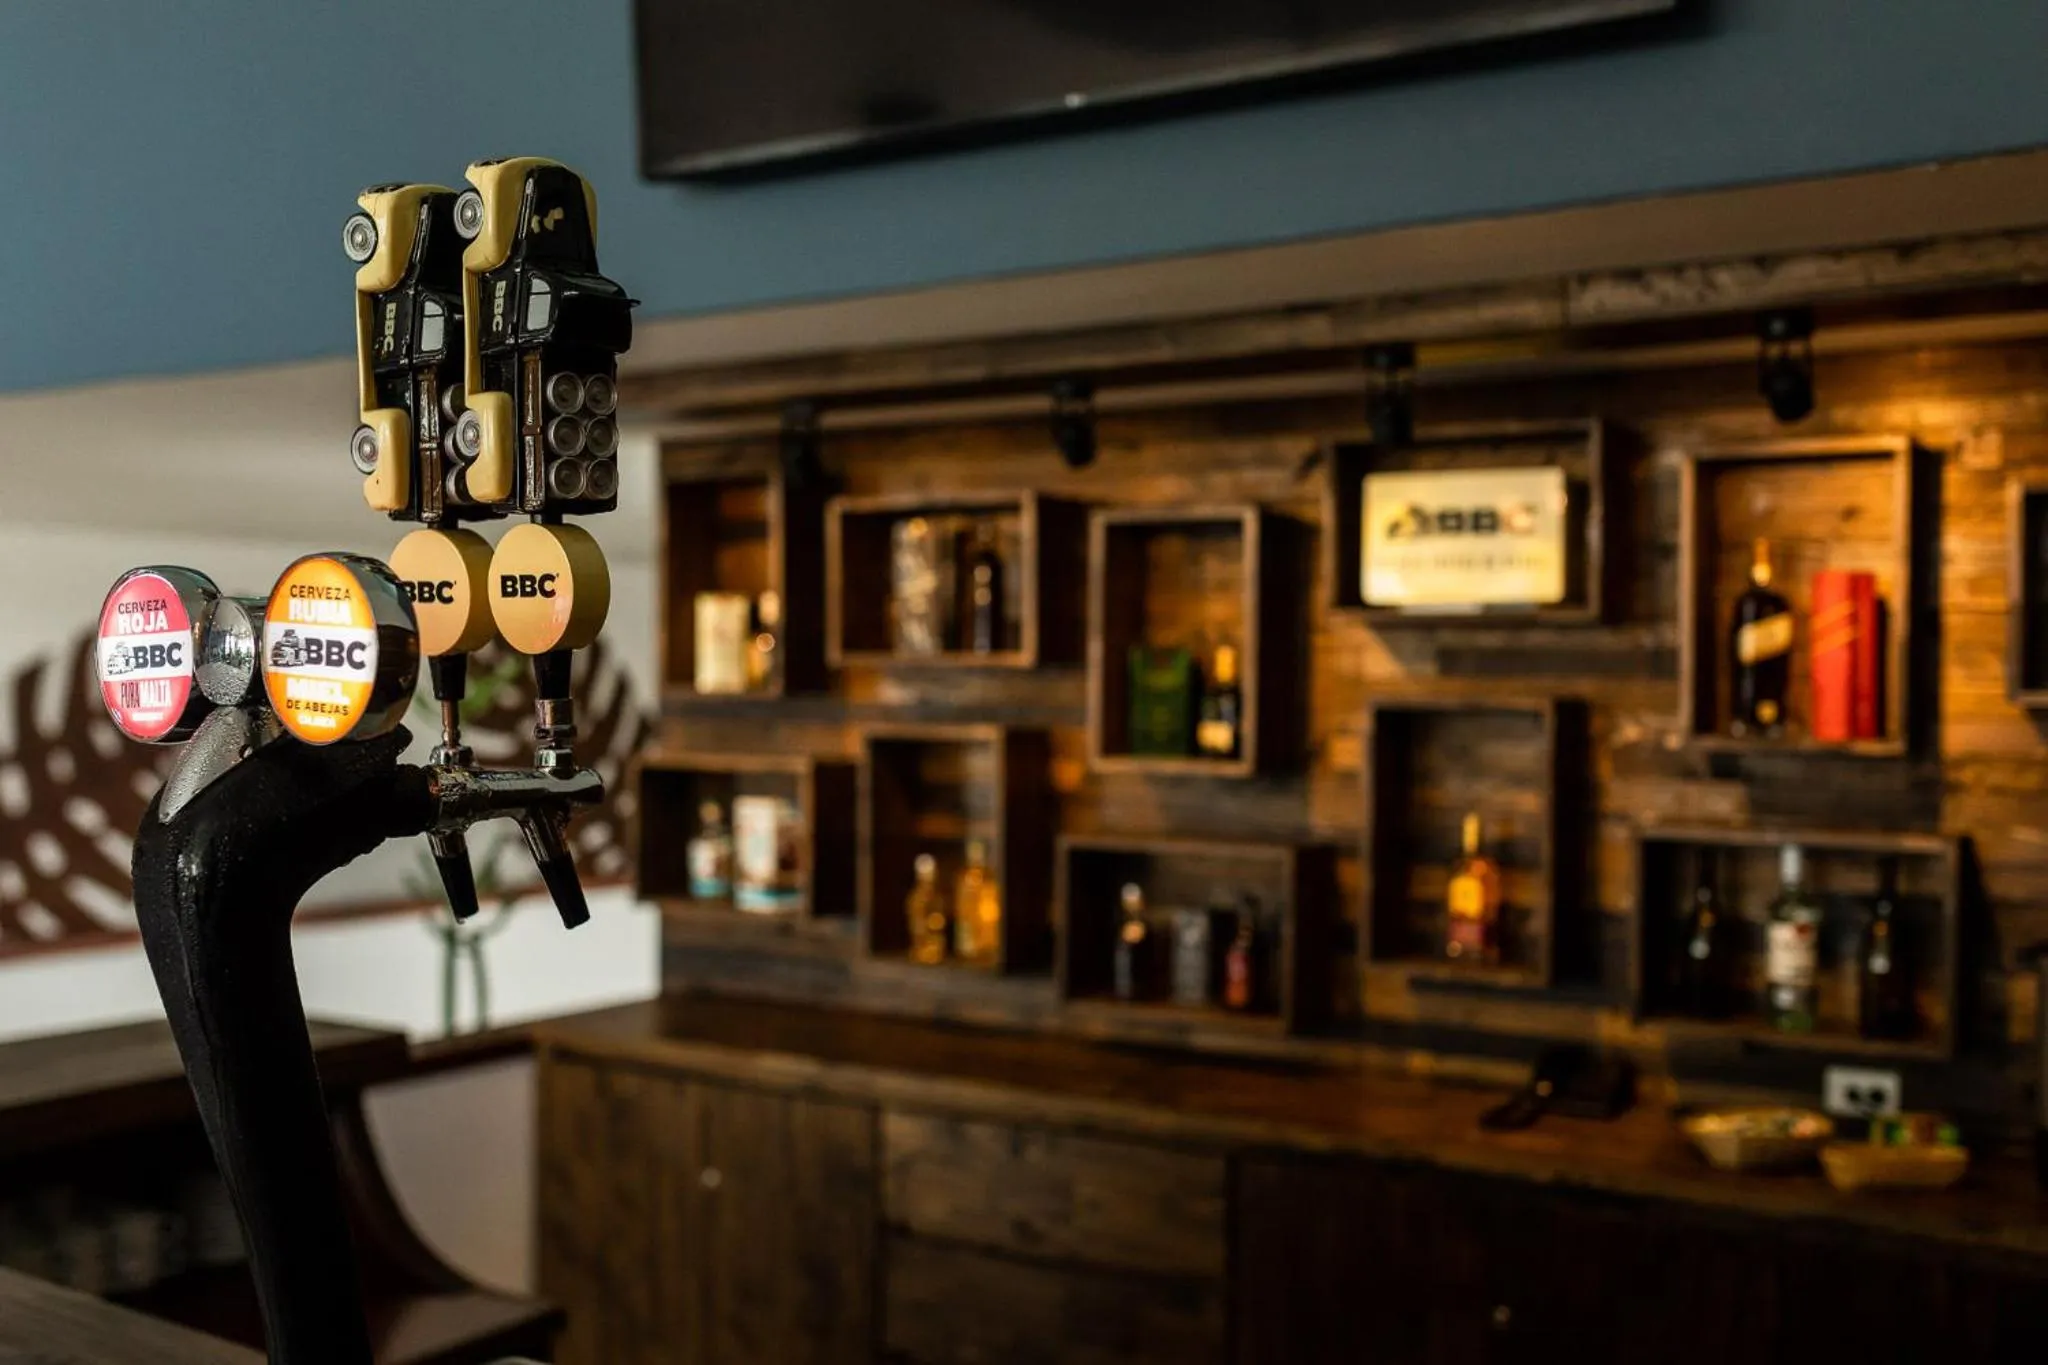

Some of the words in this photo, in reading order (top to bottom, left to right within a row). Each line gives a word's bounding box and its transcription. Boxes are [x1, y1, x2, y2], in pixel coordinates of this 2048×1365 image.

[492, 280, 506, 332] BBC
[383, 302, 396, 352] BBC
[290, 584, 352, 601] CERVEZA
[501, 573, 557, 598] BBC
[117, 599, 168, 615] CERVEZA
[117, 610, 169, 635] ROJA
[132, 642, 183, 669] BBC
[304, 637, 367, 670] BBC
[286, 699, 301, 711] DE
[304, 700, 350, 716] ABEJAS
